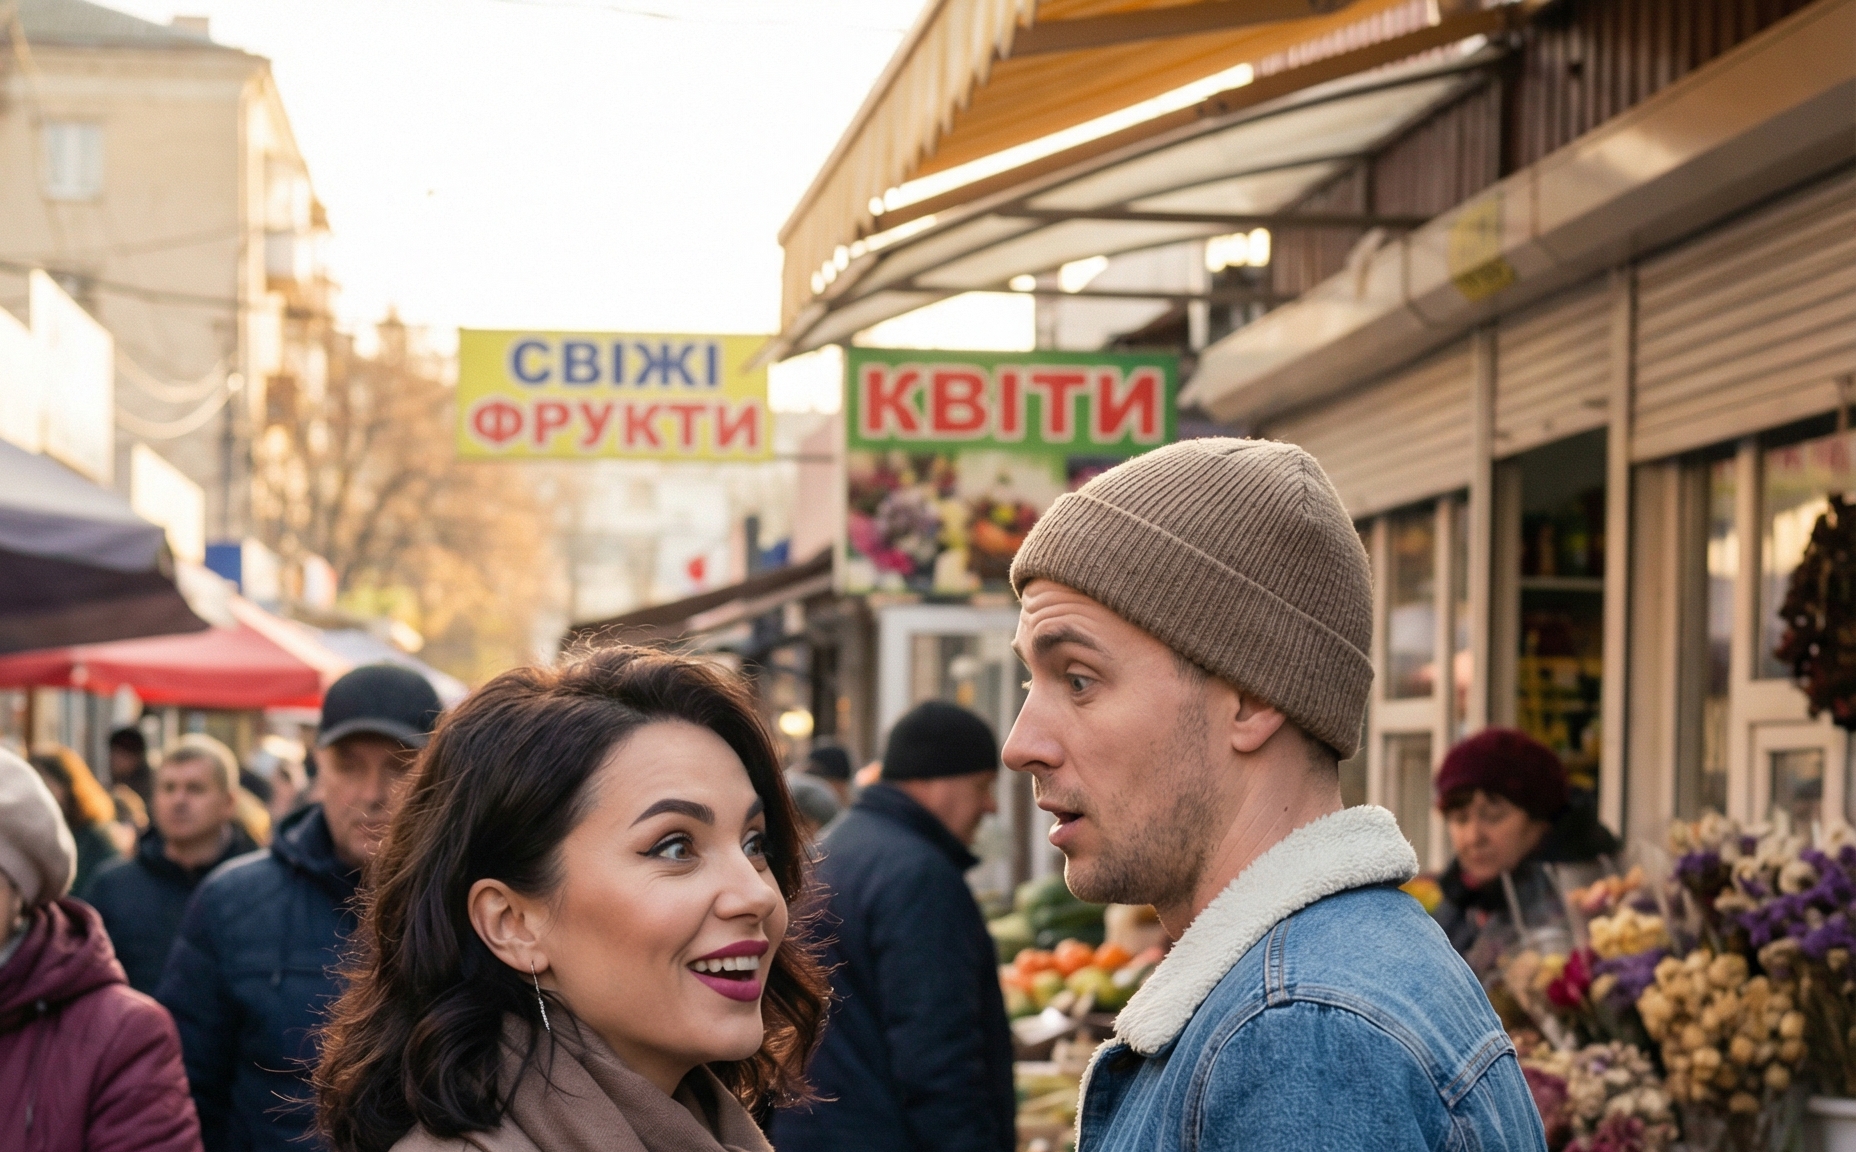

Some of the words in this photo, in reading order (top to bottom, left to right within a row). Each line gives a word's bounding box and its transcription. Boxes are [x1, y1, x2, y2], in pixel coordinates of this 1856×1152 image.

[511, 340, 719, 387] СВІЖІ
[472, 401, 759, 447] ФРУКТИ
[865, 369, 1156, 437] КВІТИ
